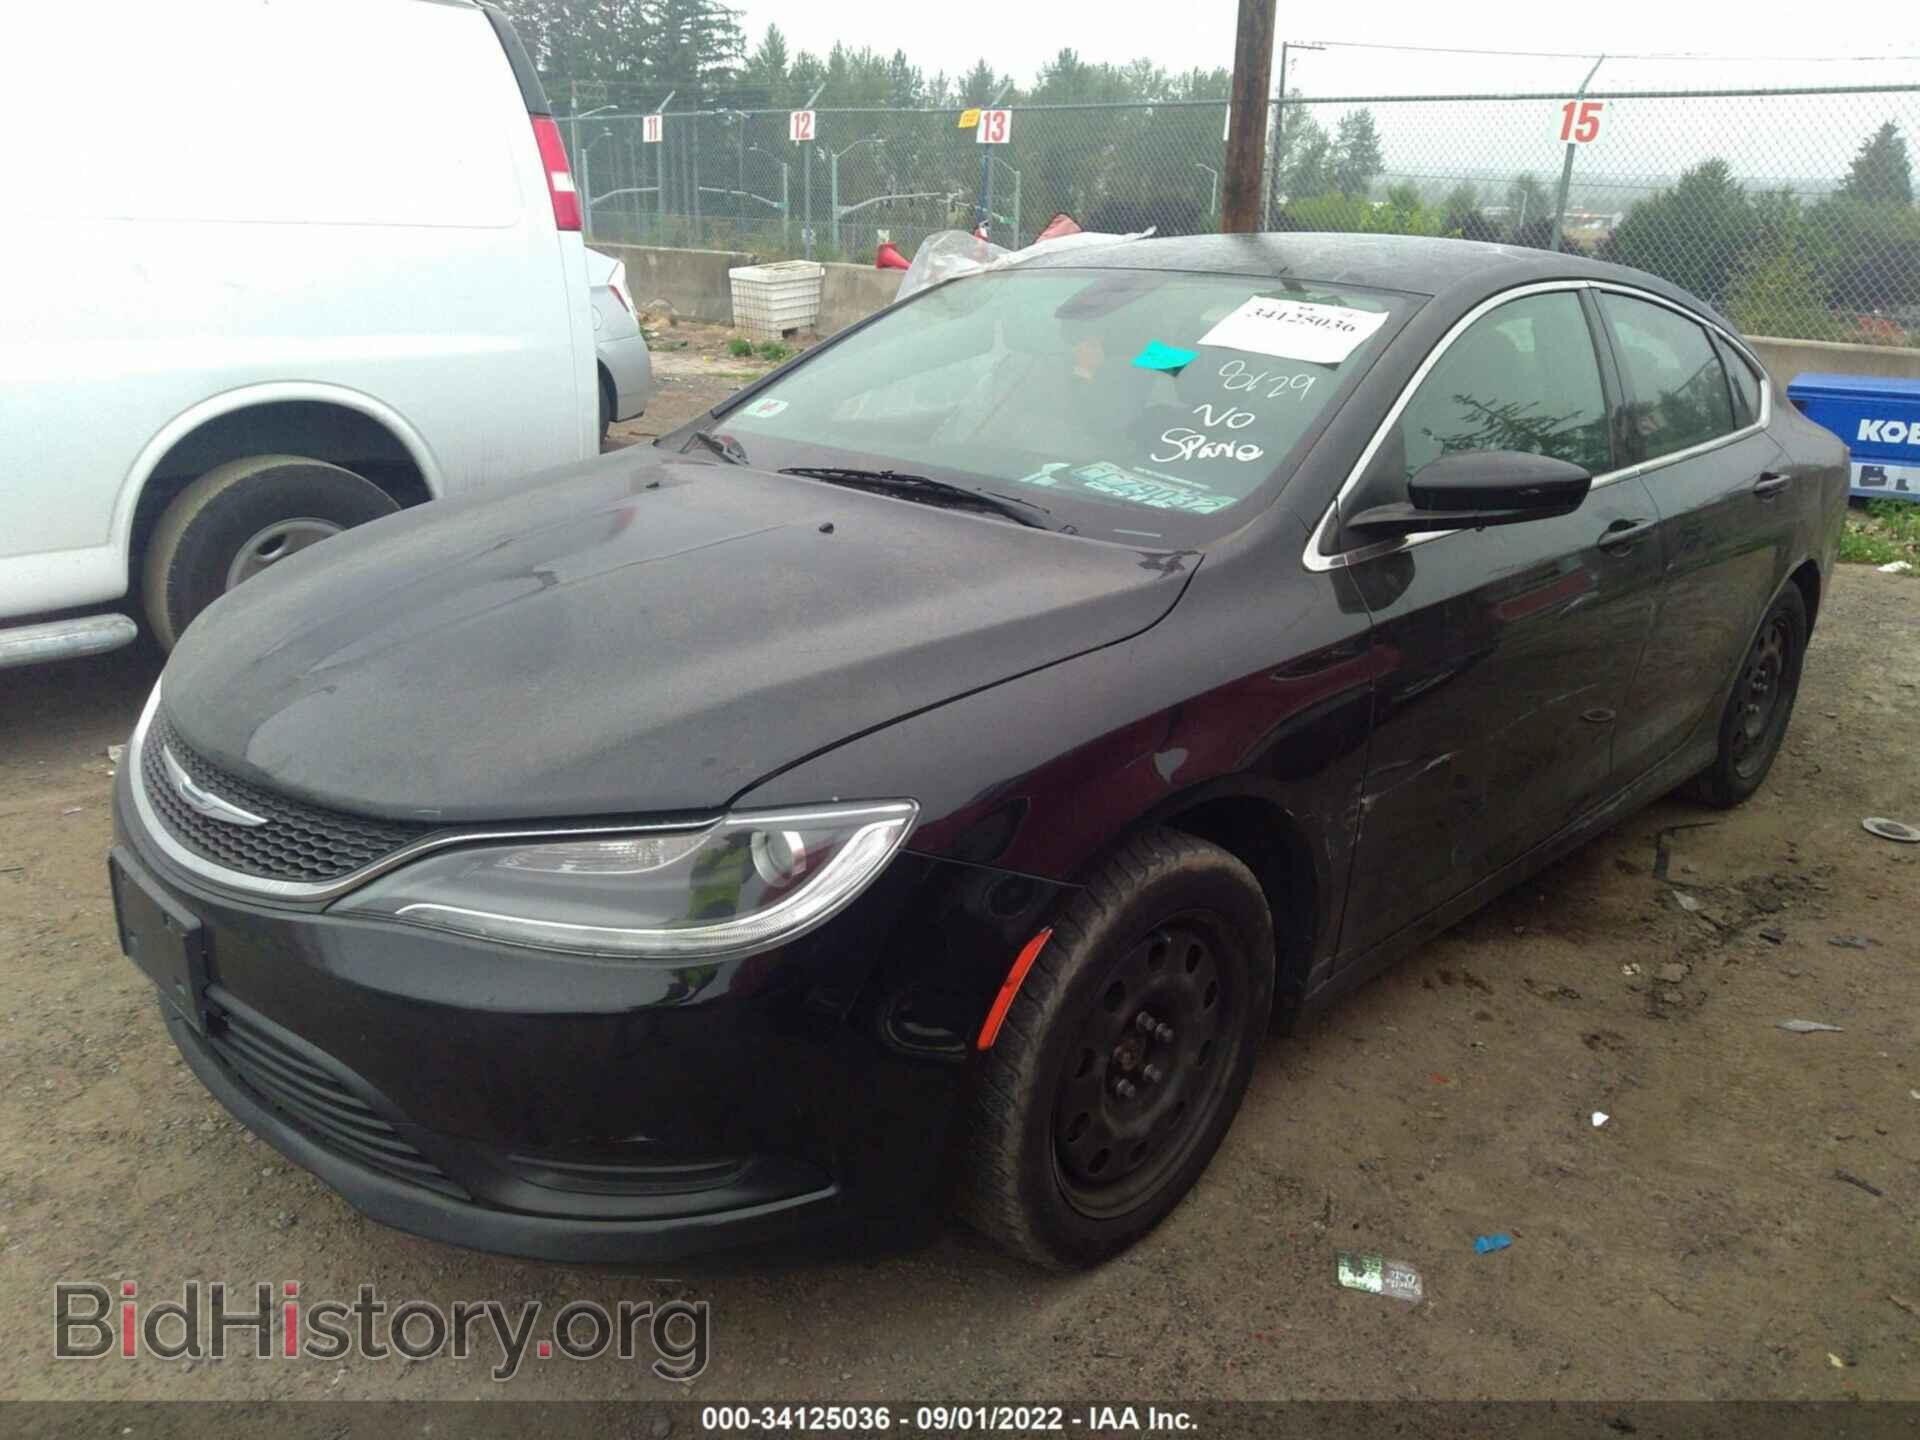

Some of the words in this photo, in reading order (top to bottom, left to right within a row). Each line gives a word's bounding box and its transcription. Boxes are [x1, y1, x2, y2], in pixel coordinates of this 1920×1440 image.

[647, 117, 658, 141] 11
[794, 112, 811, 138] 12
[983, 111, 1005, 142] 13
[1560, 101, 1604, 143] 15
